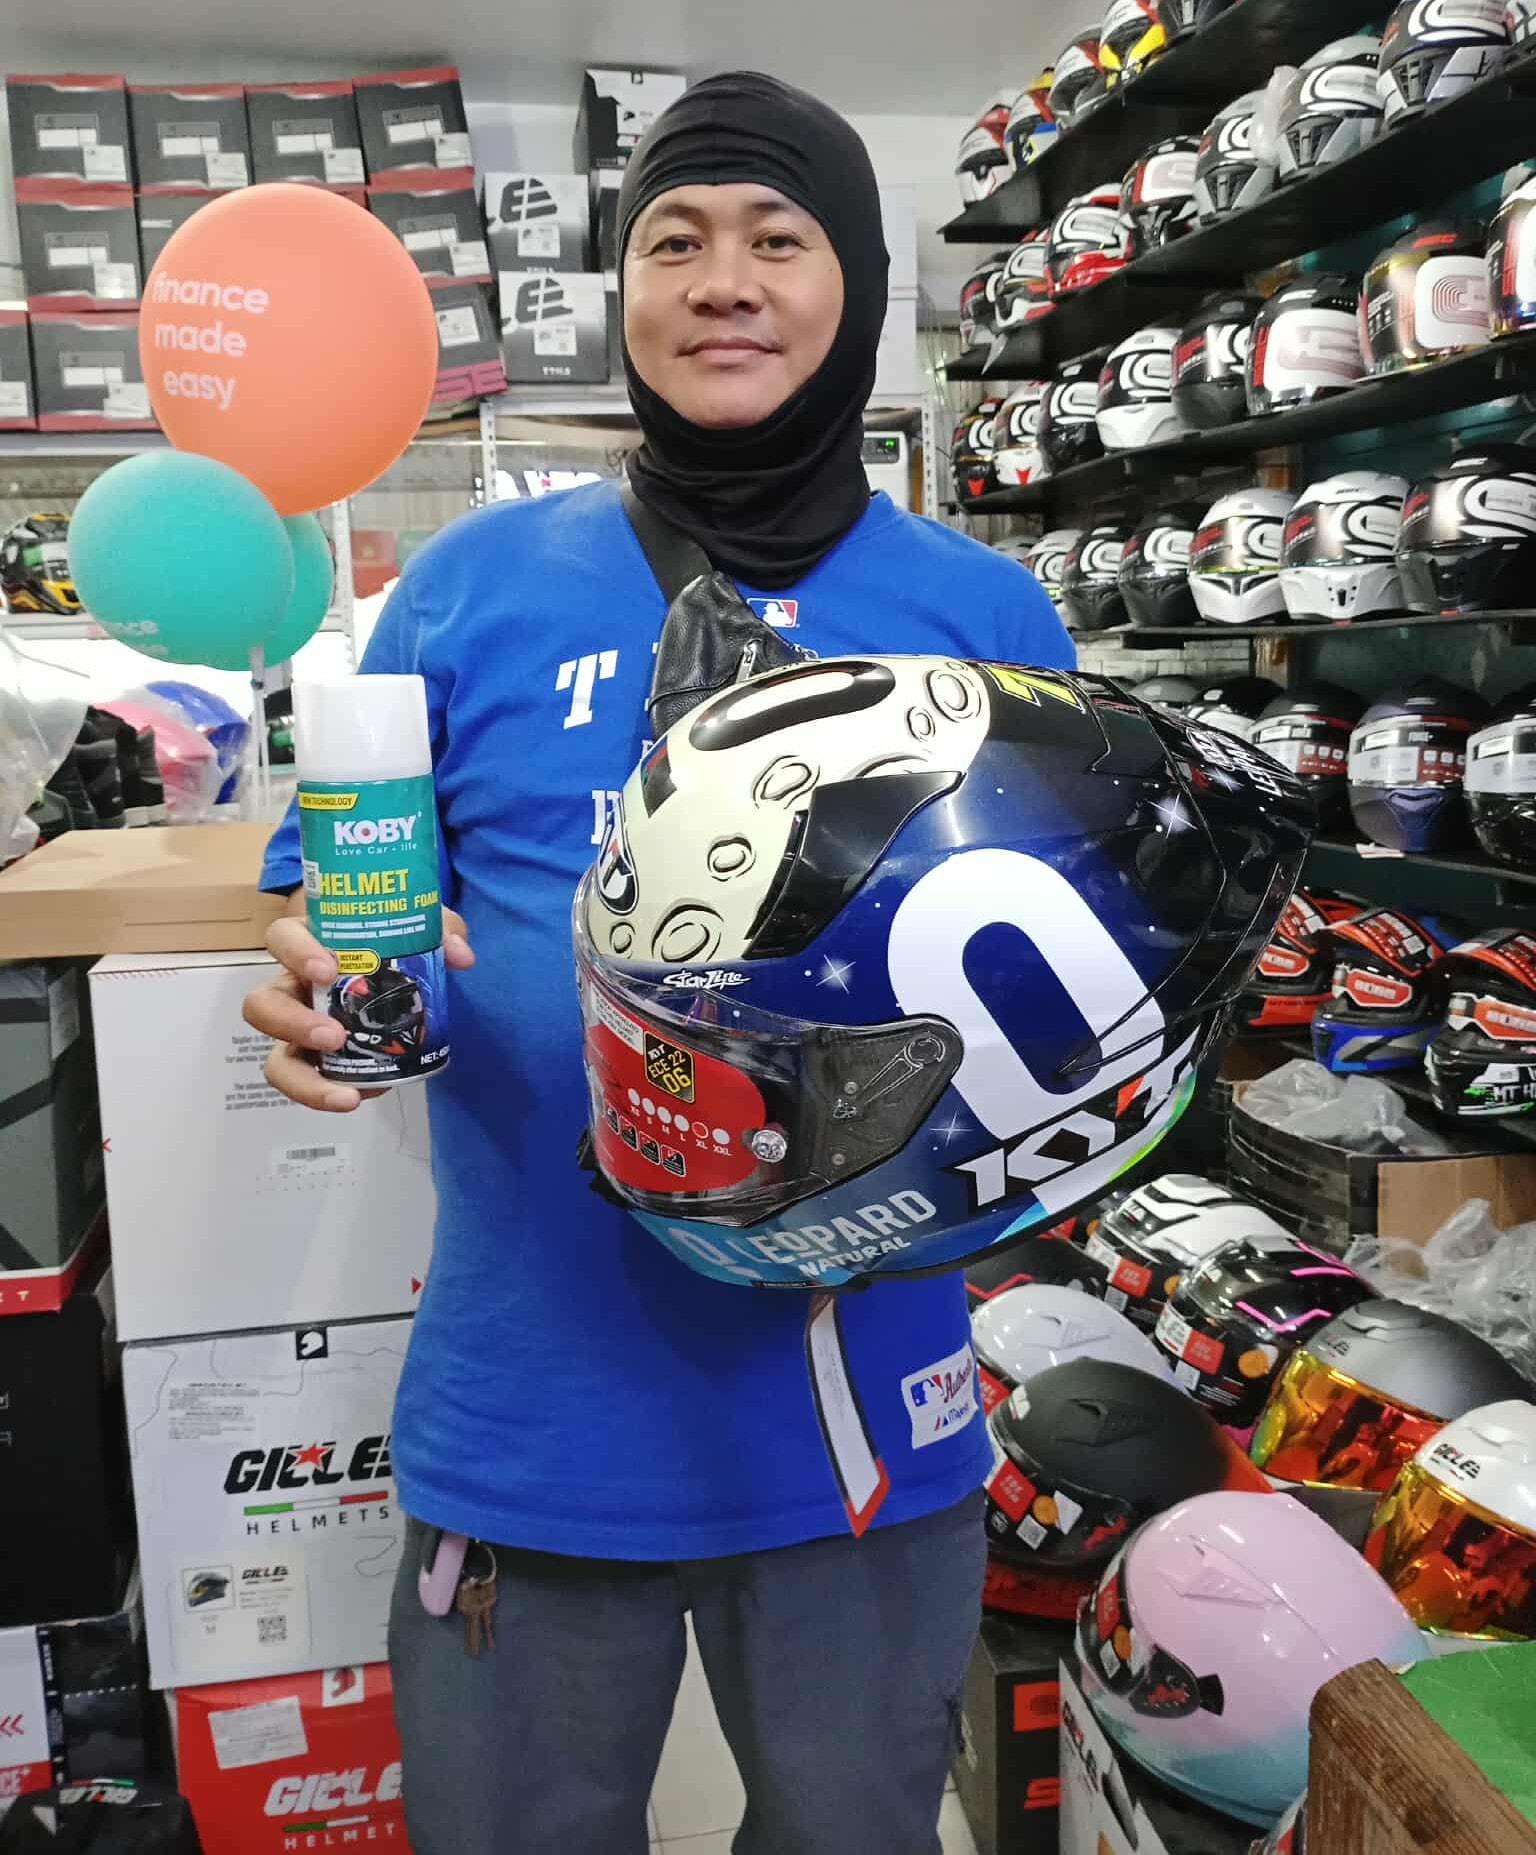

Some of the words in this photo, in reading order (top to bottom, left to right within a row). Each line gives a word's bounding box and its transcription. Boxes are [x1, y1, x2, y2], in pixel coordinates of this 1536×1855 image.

[152, 270, 269, 315] finance
[154, 320, 247, 357] made
[163, 369, 236, 411] easy
[333, 814, 417, 846] KOBY
[335, 847, 361, 856] Love
[367, 845, 388, 854] Car
[319, 868, 409, 896] HELMET
[319, 898, 407, 916] DISINFECTING
[648, 1062, 672, 1079] ECE
[668, 1050, 687, 1067] 22
[663, 1068, 691, 1093] 06
[696, 1138, 709, 1150] XL
[713, 1144, 733, 1156] XXL
[797, 1236, 912, 1277] NATURAL
[246, 1506, 389, 1535] HELMETS
[284, 1823, 395, 1850] HELMET
